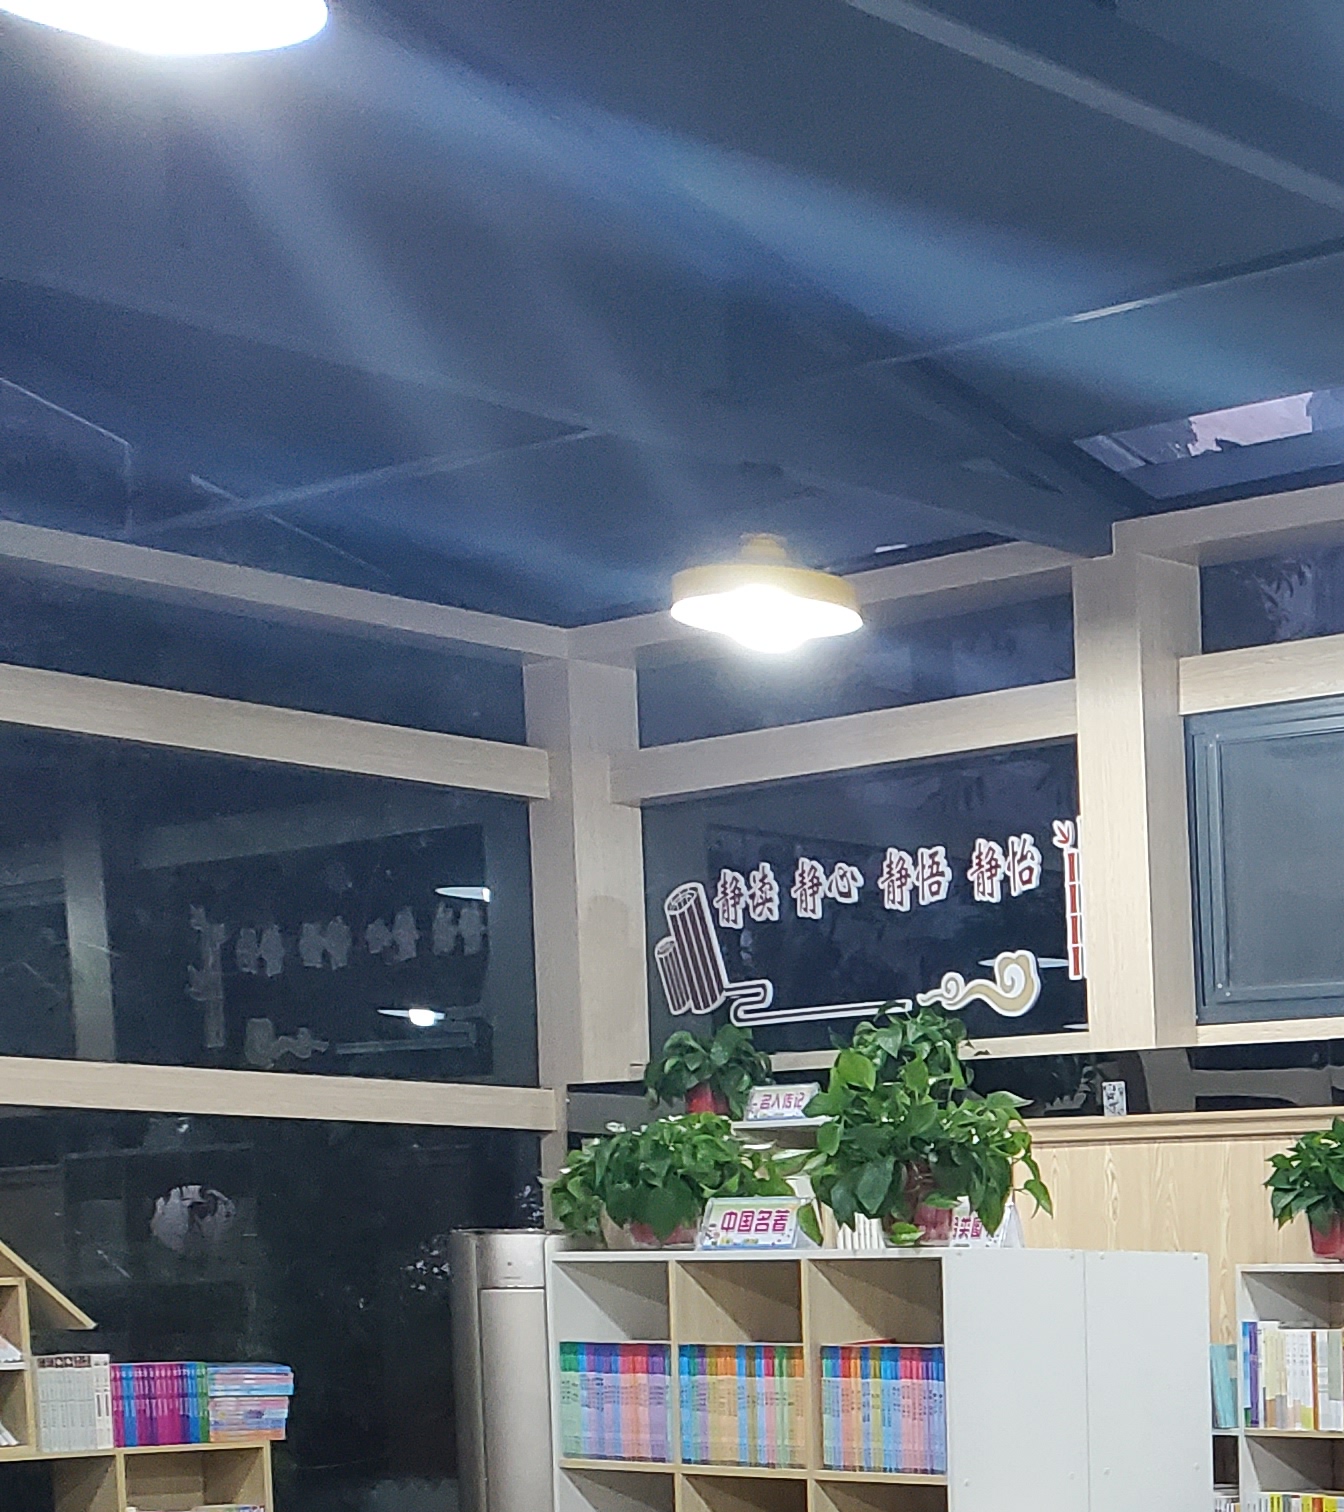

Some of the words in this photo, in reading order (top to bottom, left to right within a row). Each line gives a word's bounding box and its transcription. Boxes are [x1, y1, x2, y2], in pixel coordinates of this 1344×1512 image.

[713, 864, 779, 927] 静读
[791, 858, 863, 918] 静心
[879, 848, 950, 911] 静悟
[968, 835, 1042, 902] 静怡
[759, 1092, 805, 1110] 名人传记
[720, 1209, 791, 1235] 中国名著
